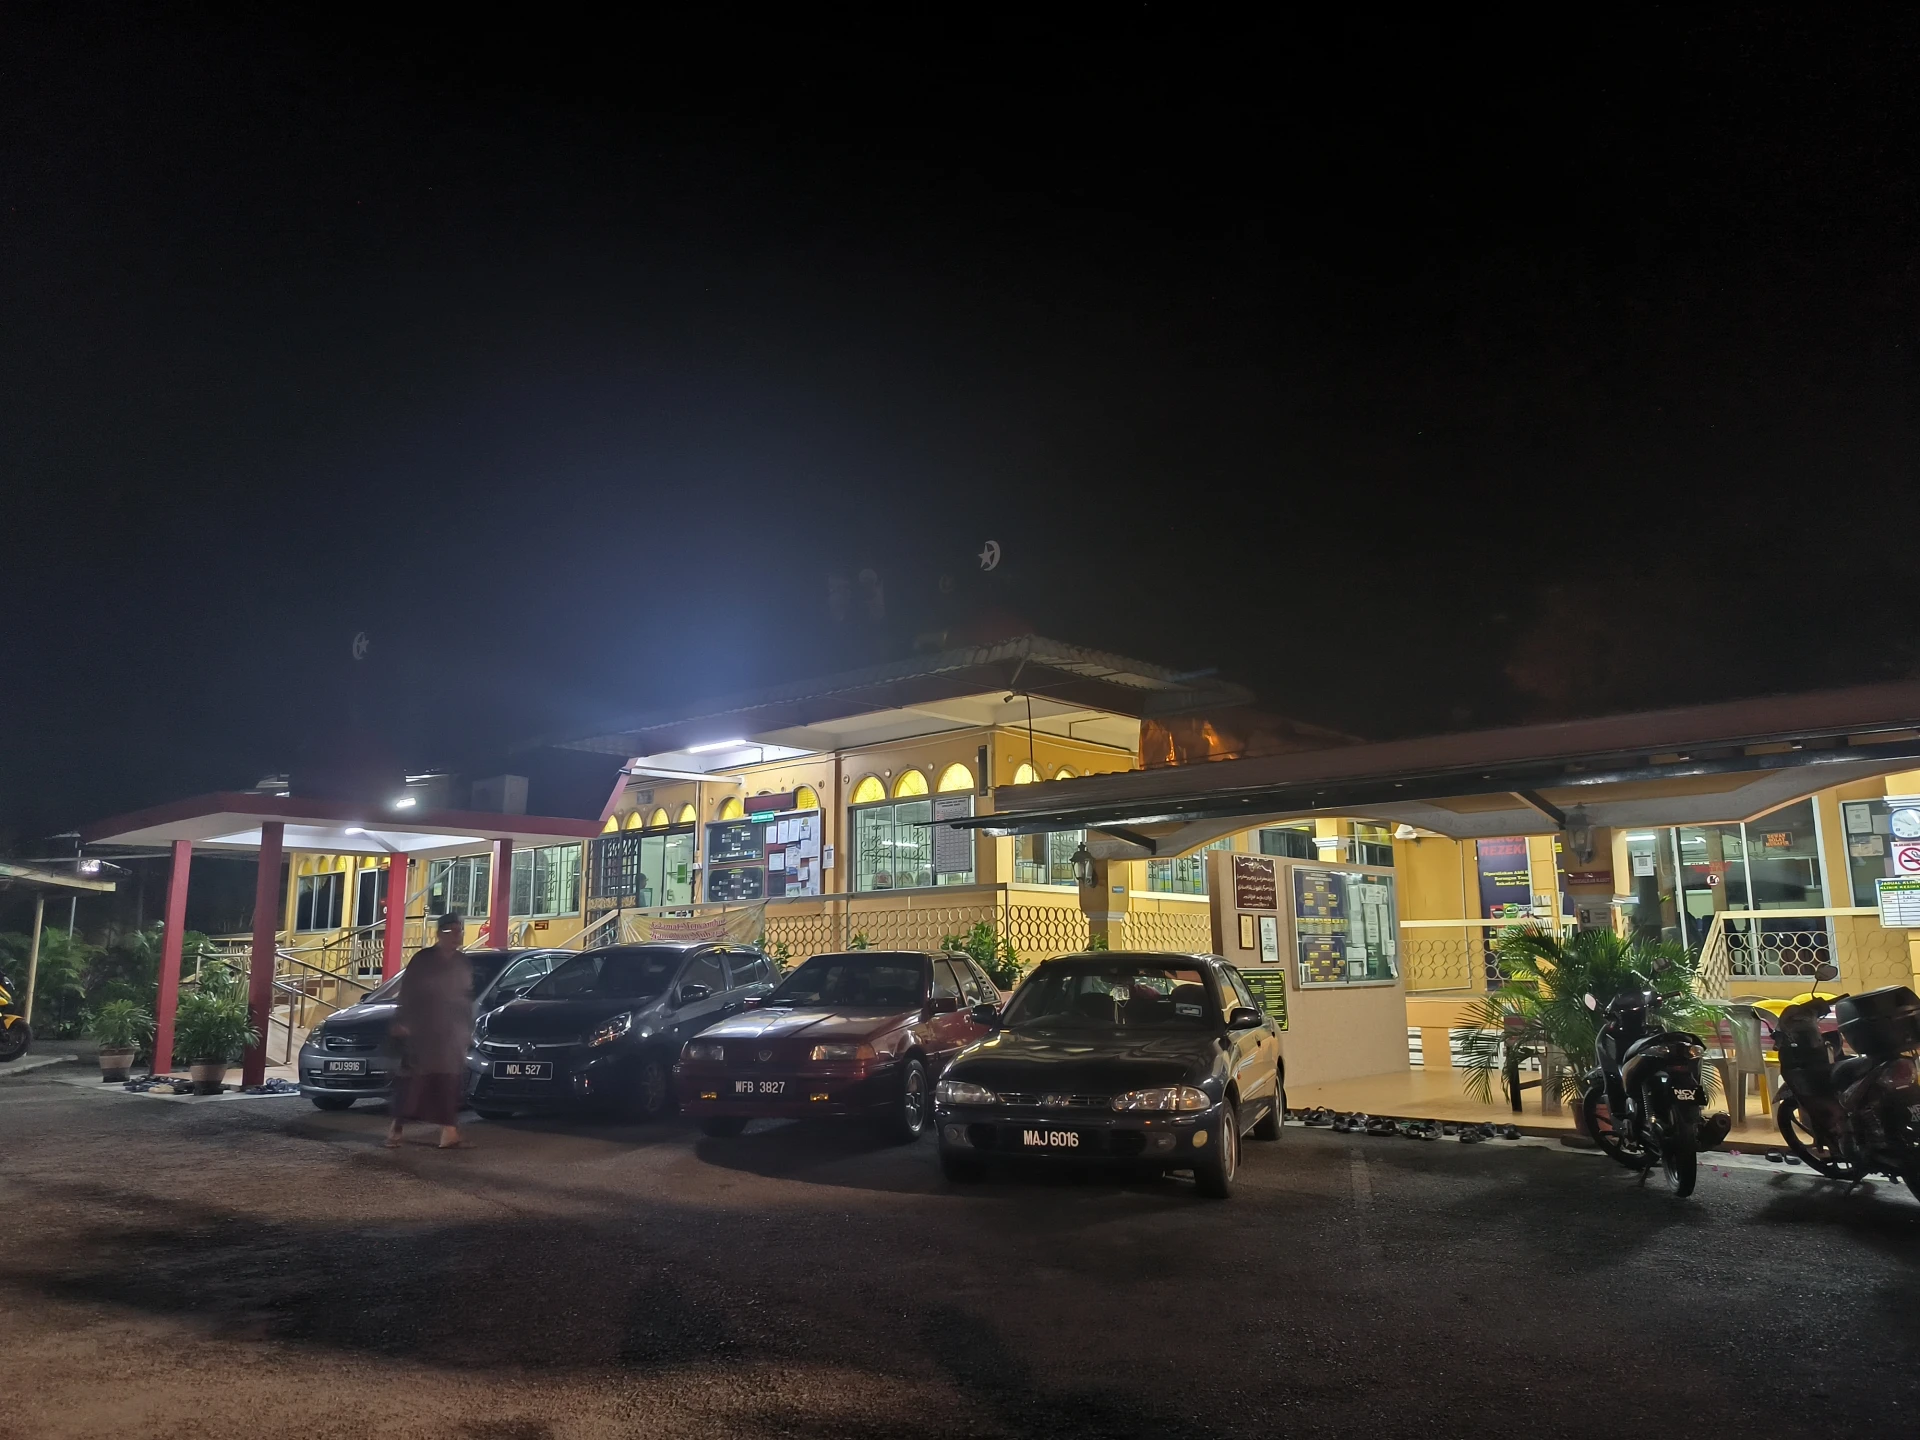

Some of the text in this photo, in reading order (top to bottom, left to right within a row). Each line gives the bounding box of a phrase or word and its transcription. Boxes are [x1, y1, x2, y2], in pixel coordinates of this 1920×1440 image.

[1481, 844, 1526, 856] REZEKI
[506, 1064, 541, 1076] NDL 527
[735, 1081, 785, 1094] WFB 3827
[1023, 1130, 1079, 1147] MAJ 6016
